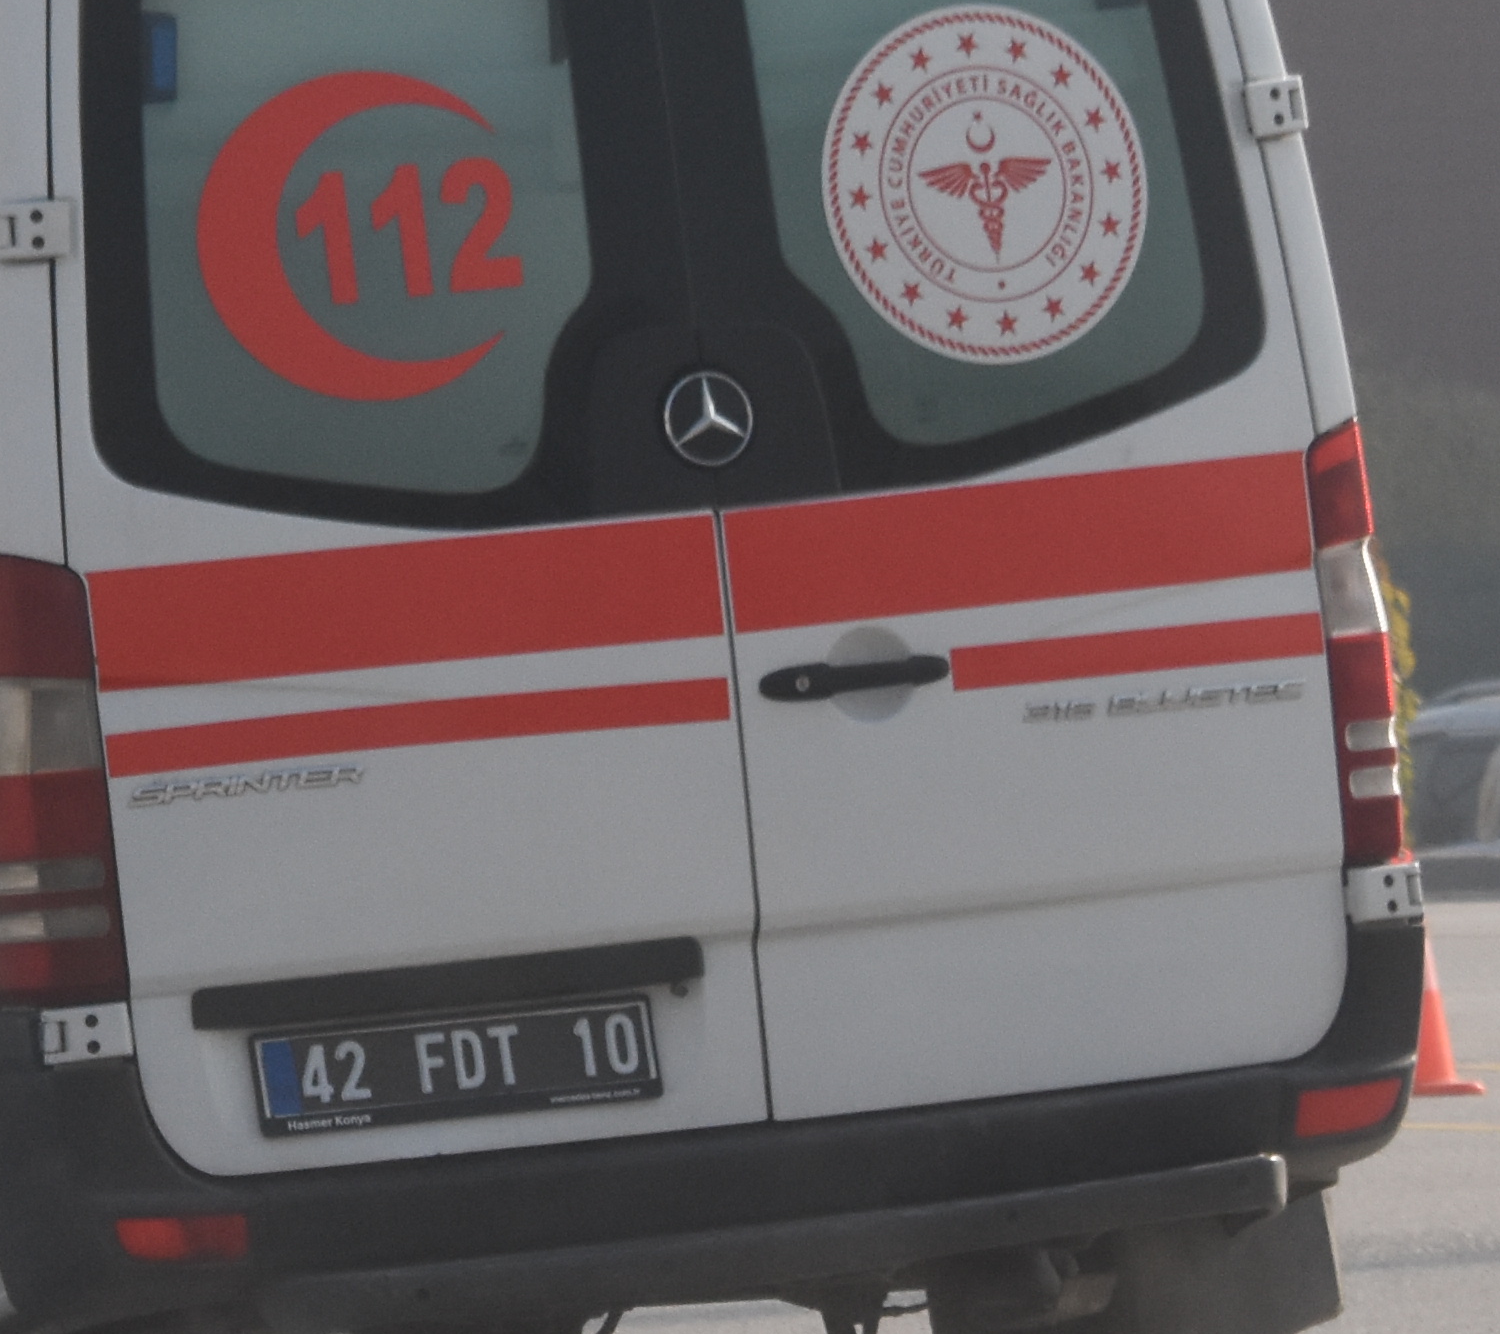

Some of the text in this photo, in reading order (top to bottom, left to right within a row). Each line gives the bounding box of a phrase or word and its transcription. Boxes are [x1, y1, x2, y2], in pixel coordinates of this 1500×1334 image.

[293, 156, 525, 307] 112
[128, 765, 364, 809] SPRINTER
[302, 1011, 641, 1104] 42 FDT 10
[334, 1113, 372, 1126] Konya
